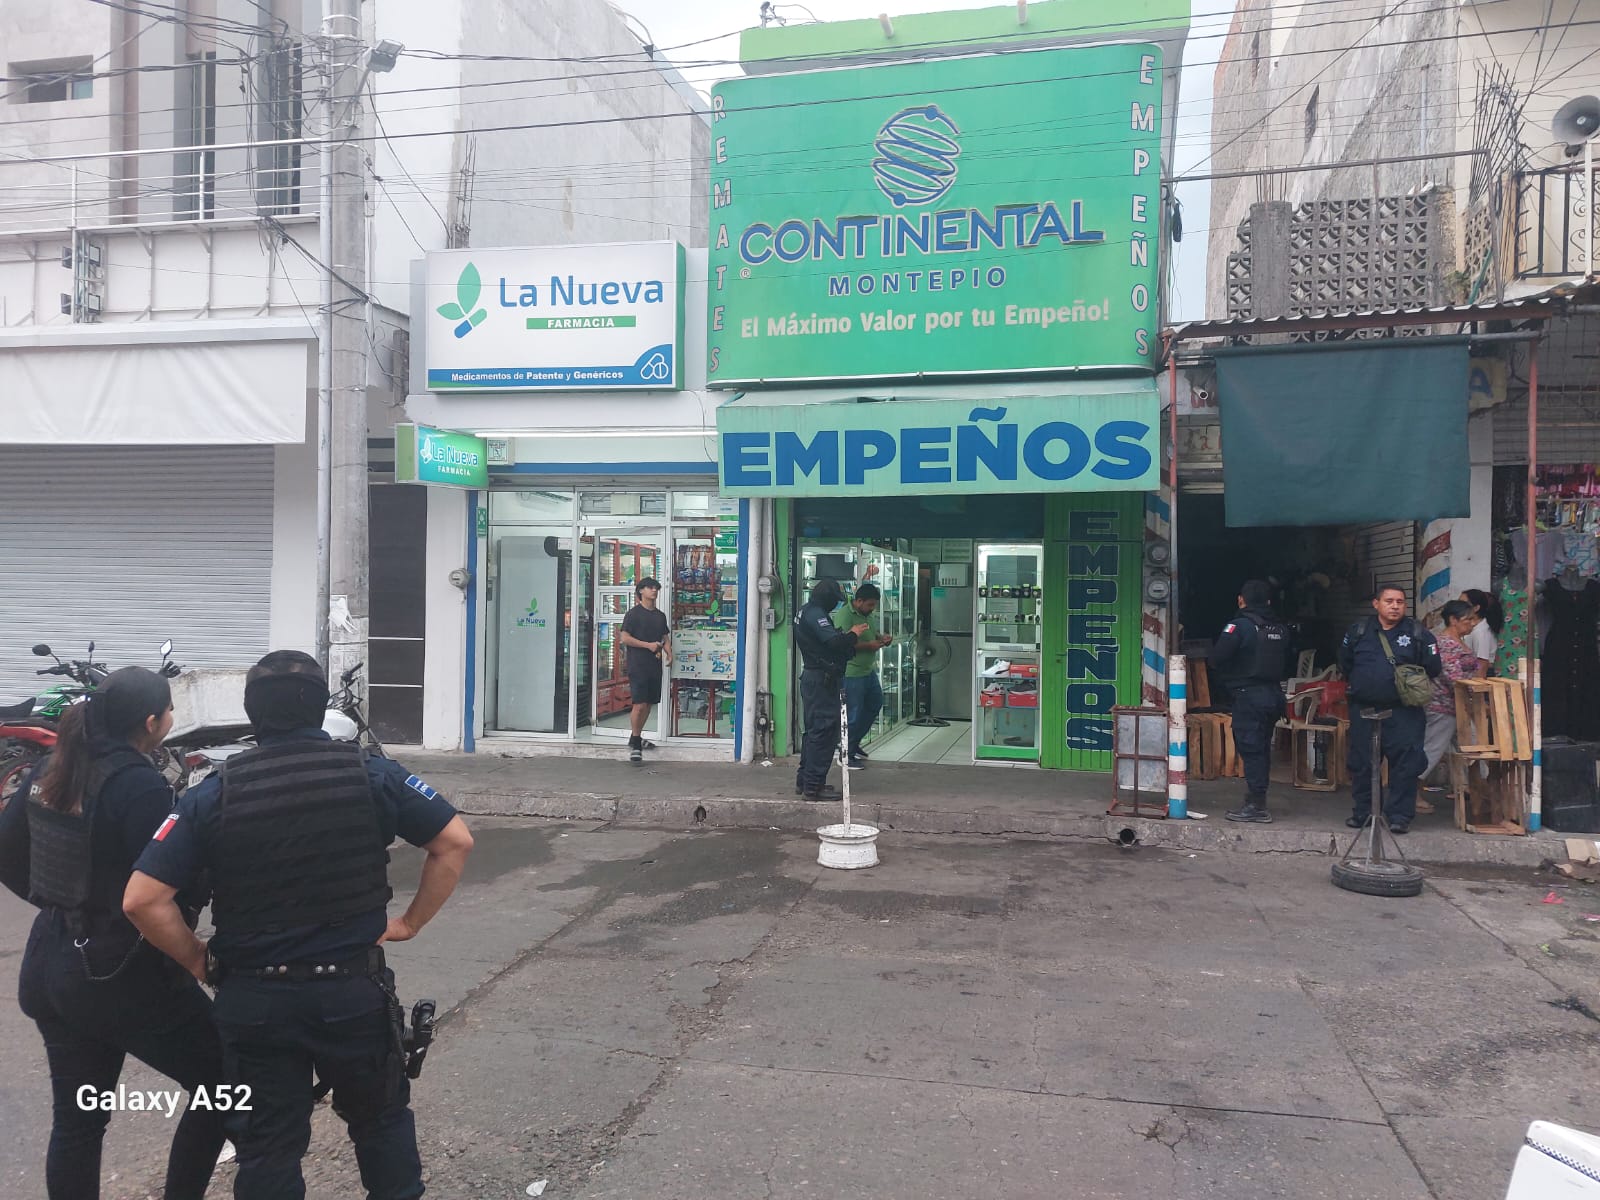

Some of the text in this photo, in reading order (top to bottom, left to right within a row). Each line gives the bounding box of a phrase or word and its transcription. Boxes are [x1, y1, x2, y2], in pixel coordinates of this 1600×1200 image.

[738, 200, 1105, 266] CONTINENTAL
[500, 275, 663, 308] La Nueva
[828, 266, 1008, 297] MONTEPIO
[547, 317, 615, 329] FARMACIA
[741, 299, 1110, 339] El Máximo Valor por tu Empeño!
[451, 370, 624, 382] Medicamentos de Patente y Genéricos
[431, 442, 479, 467] La Nueva
[723, 406, 1152, 487] EMPEÑOS
[437, 465, 471, 476] FARMACIA
[1066, 511, 1120, 751] EMPEÑOS
